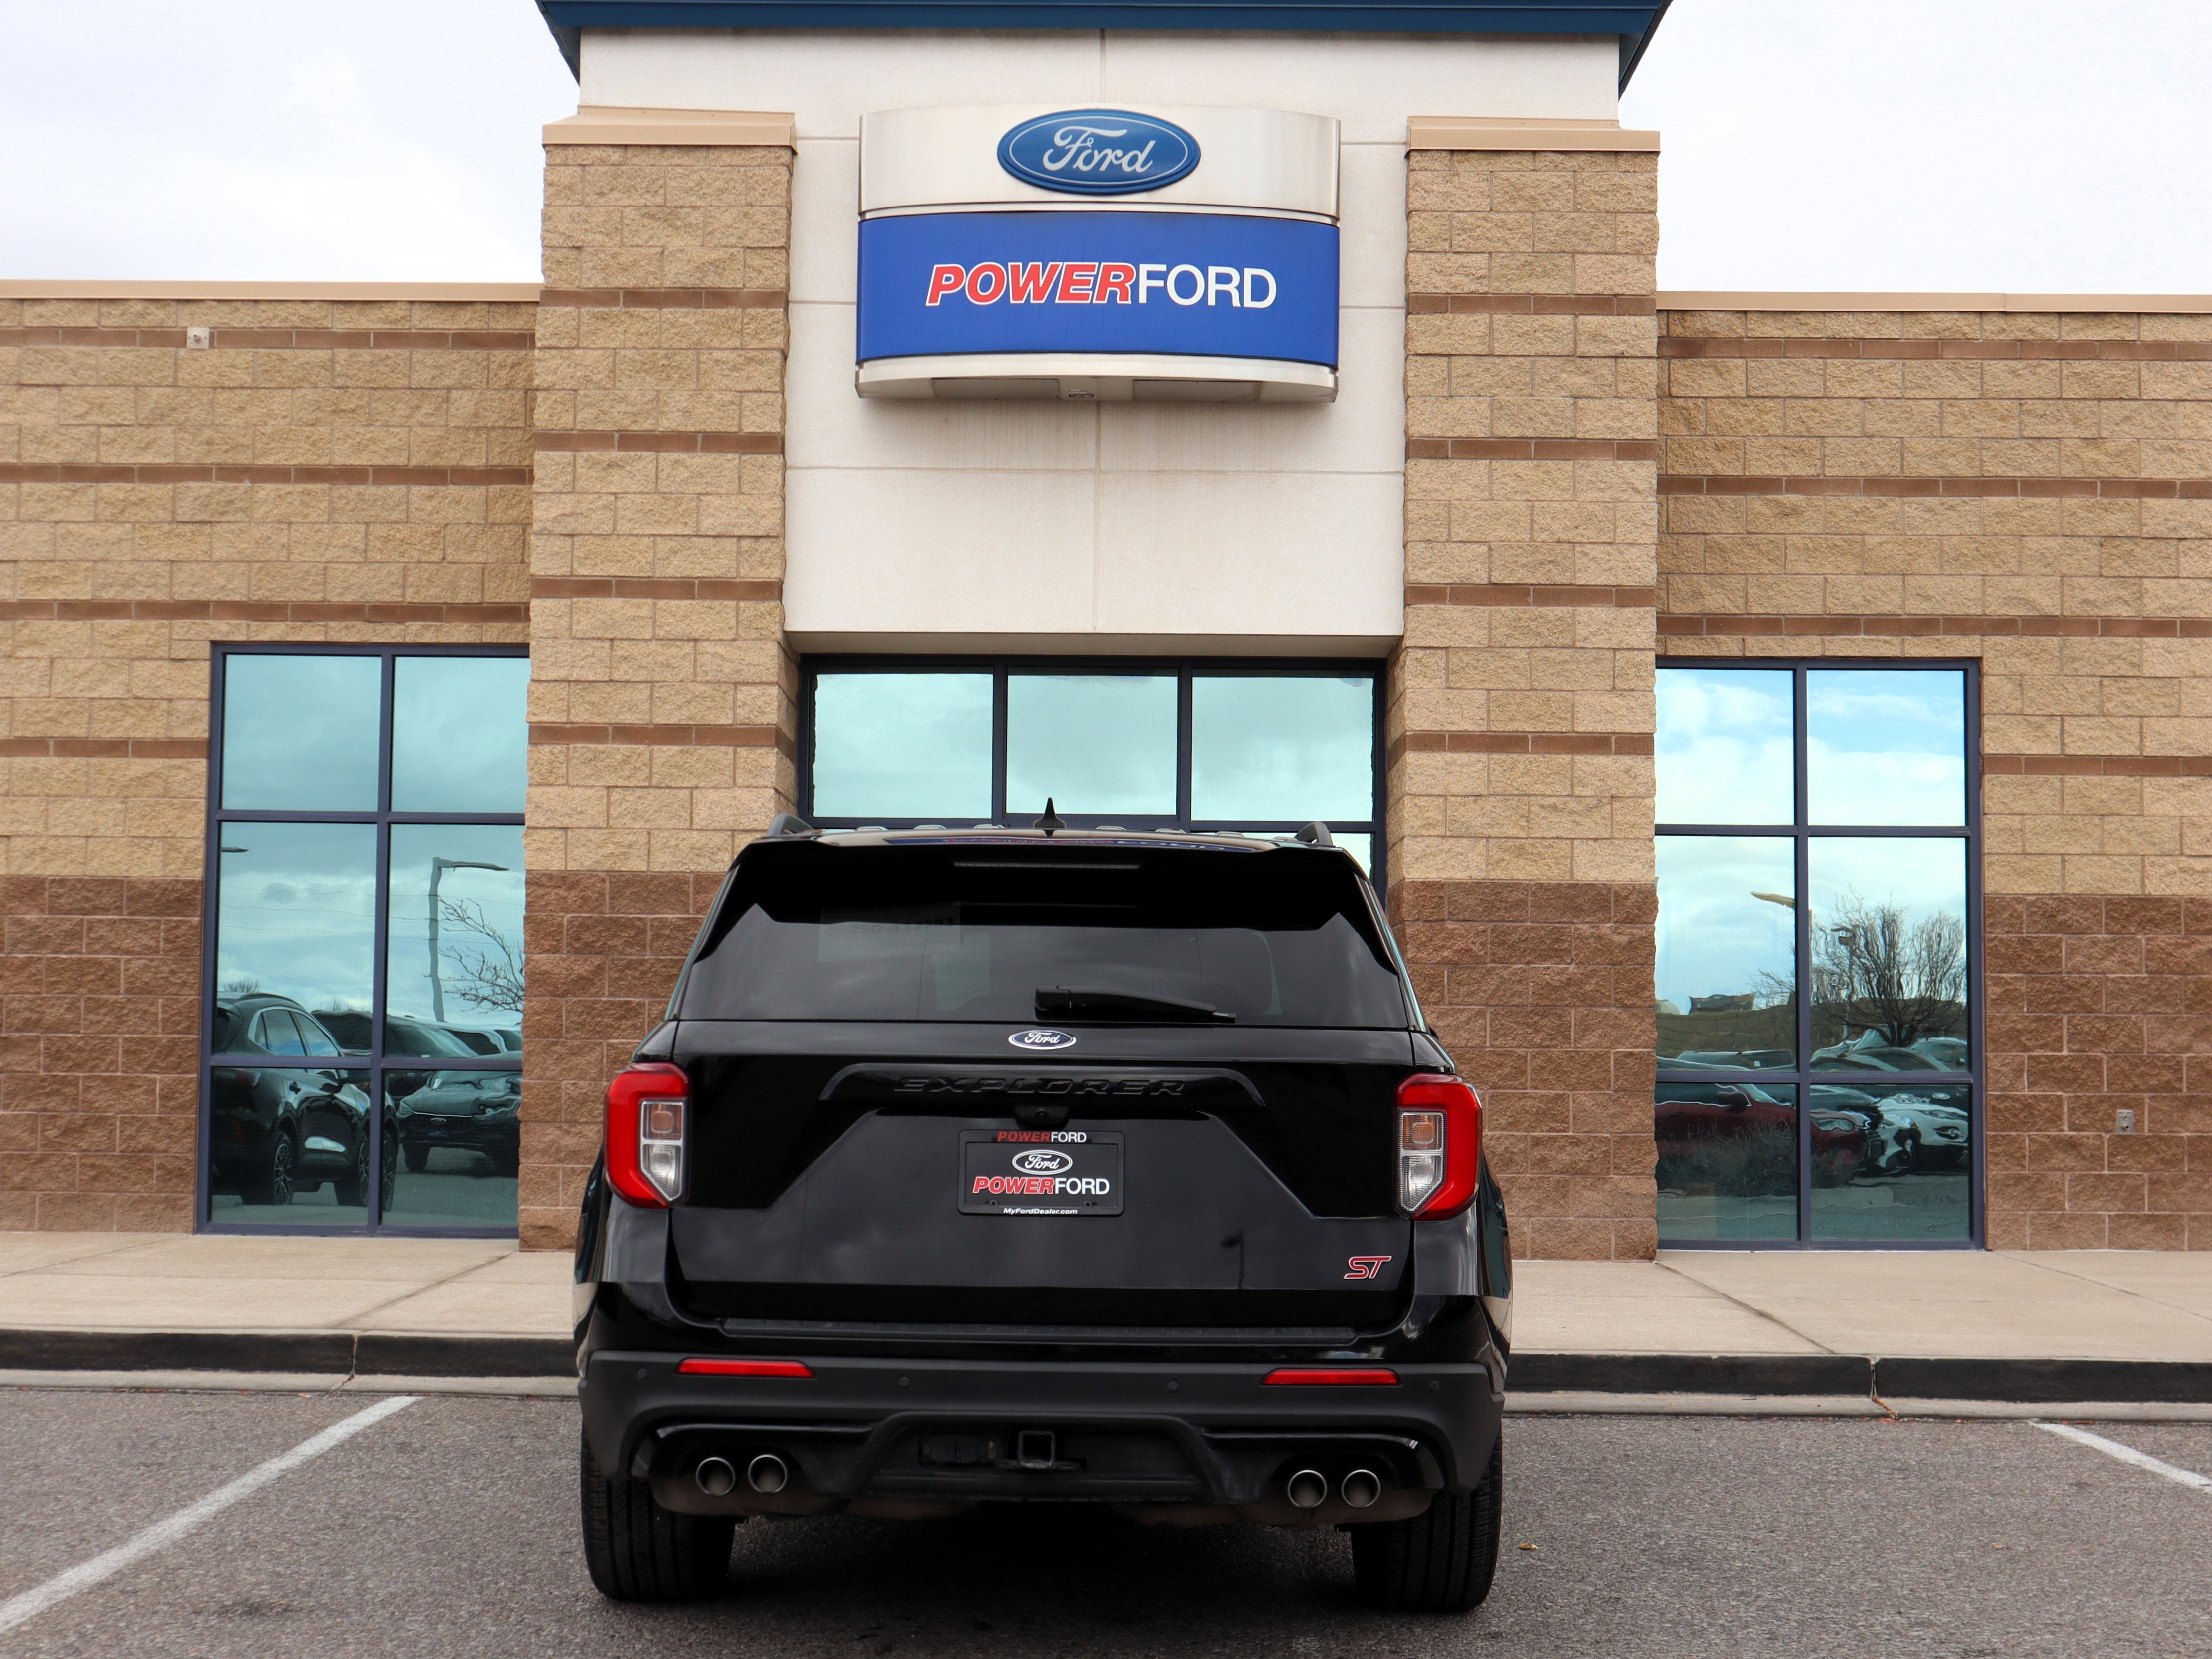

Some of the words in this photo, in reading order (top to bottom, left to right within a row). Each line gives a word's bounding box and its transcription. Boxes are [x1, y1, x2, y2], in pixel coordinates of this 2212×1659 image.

[1042, 126, 1156, 173] Ford
[925, 262, 1277, 308] POWERFORD
[1024, 1032, 1061, 1044] Ford
[893, 1076, 1185, 1095] EXPLORER
[996, 1131, 1087, 1143] POWERFORD
[1024, 1154, 1061, 1169] Ford
[972, 1176, 1110, 1195] POWERFORD
[1344, 1256, 1392, 1279] ST
